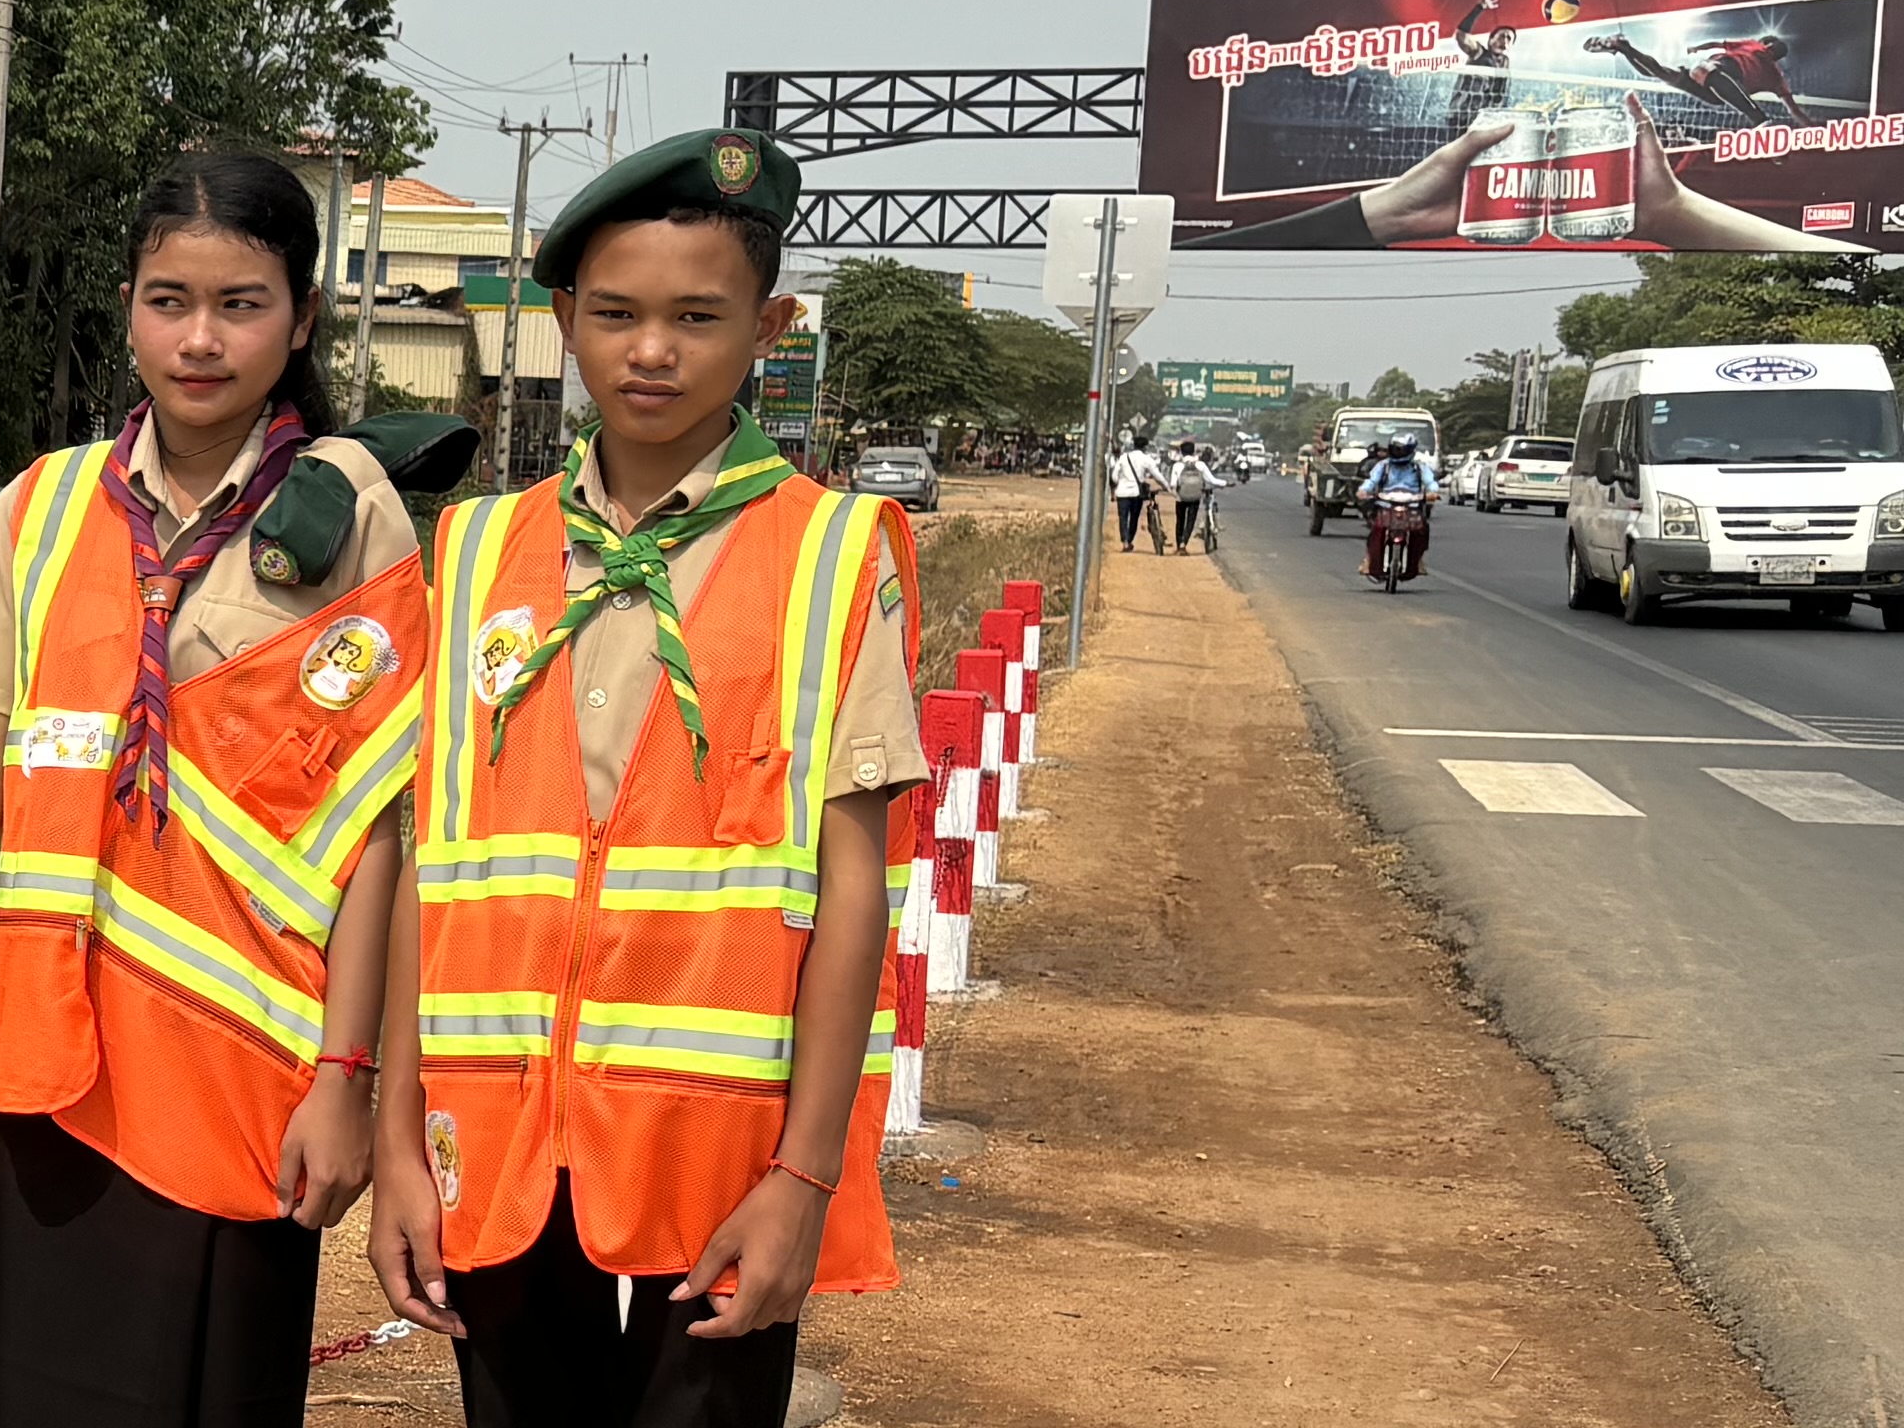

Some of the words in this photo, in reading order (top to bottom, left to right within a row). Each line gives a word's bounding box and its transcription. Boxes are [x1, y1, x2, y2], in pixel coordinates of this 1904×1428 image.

[1718, 127, 1789, 159] BOND
[1794, 129, 1824, 147] FOR
[1828, 115, 1904, 149] MORE
[1487, 166, 1596, 200] CAMBODIA
